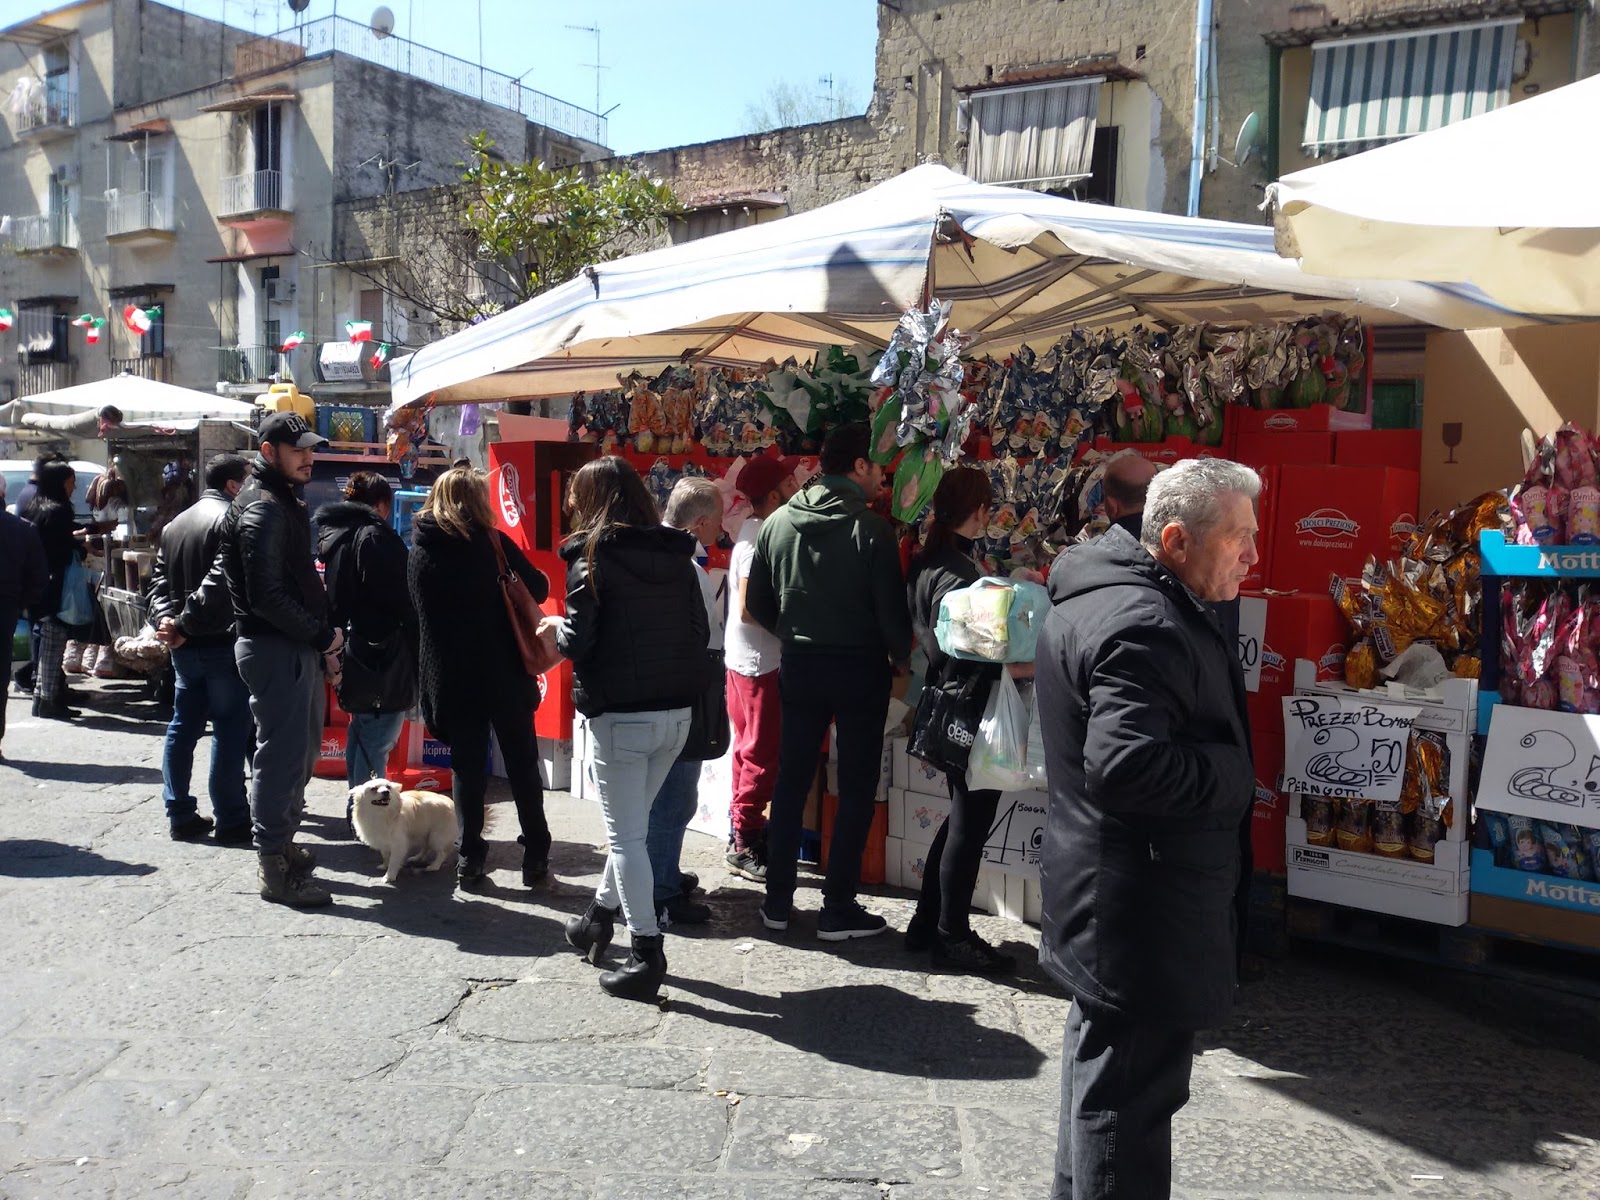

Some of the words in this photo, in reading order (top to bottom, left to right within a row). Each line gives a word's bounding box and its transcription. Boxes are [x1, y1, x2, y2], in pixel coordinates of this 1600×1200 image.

[1303, 519, 1324, 529] DOLCI
[1325, 518, 1354, 530] PREZIOSI
[1299, 538, 1353, 550] www.dolcipreziosi.it
[1289, 699, 1360, 729] PREZZO
[1361, 706, 1415, 728] BOMBA
[1526, 879, 1600, 906] Motta
